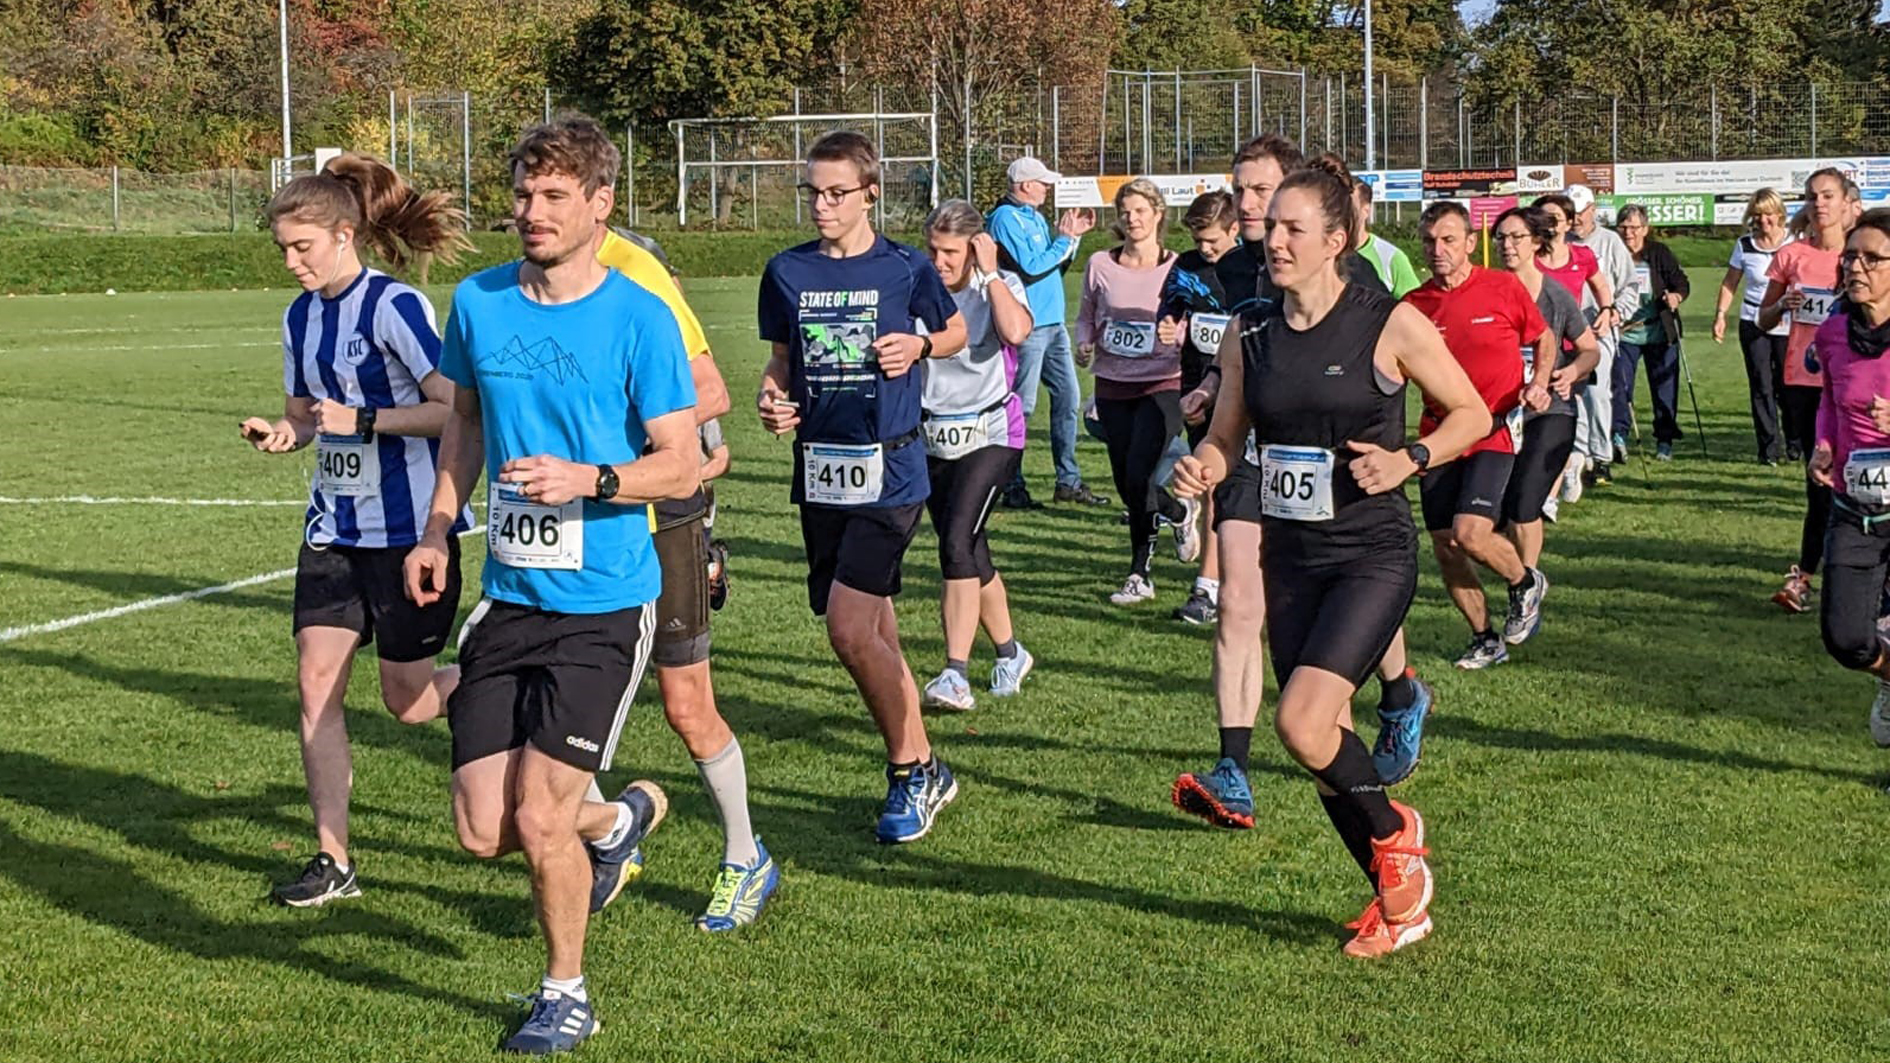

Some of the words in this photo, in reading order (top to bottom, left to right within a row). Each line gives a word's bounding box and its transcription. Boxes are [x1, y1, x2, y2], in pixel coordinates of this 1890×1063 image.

[1423, 170, 1515, 180] Brandschutztechnik
[1172, 186, 1194, 196] Laut
[1646, 204, 1705, 223] ESSER!
[800, 291, 833, 308] STATE
[833, 291, 848, 307] OF
[848, 289, 879, 307] MIND
[1112, 330, 1145, 349] 802
[1199, 327, 1222, 344] 80
[347, 338, 363, 358] KSC
[936, 426, 974, 446] 407
[324, 451, 361, 479] 409
[818, 463, 866, 489] 410
[1270, 468, 1314, 501] 405
[1858, 466, 1889, 490] 44
[501, 512, 560, 547] 406
[566, 735, 599, 753] adidas
